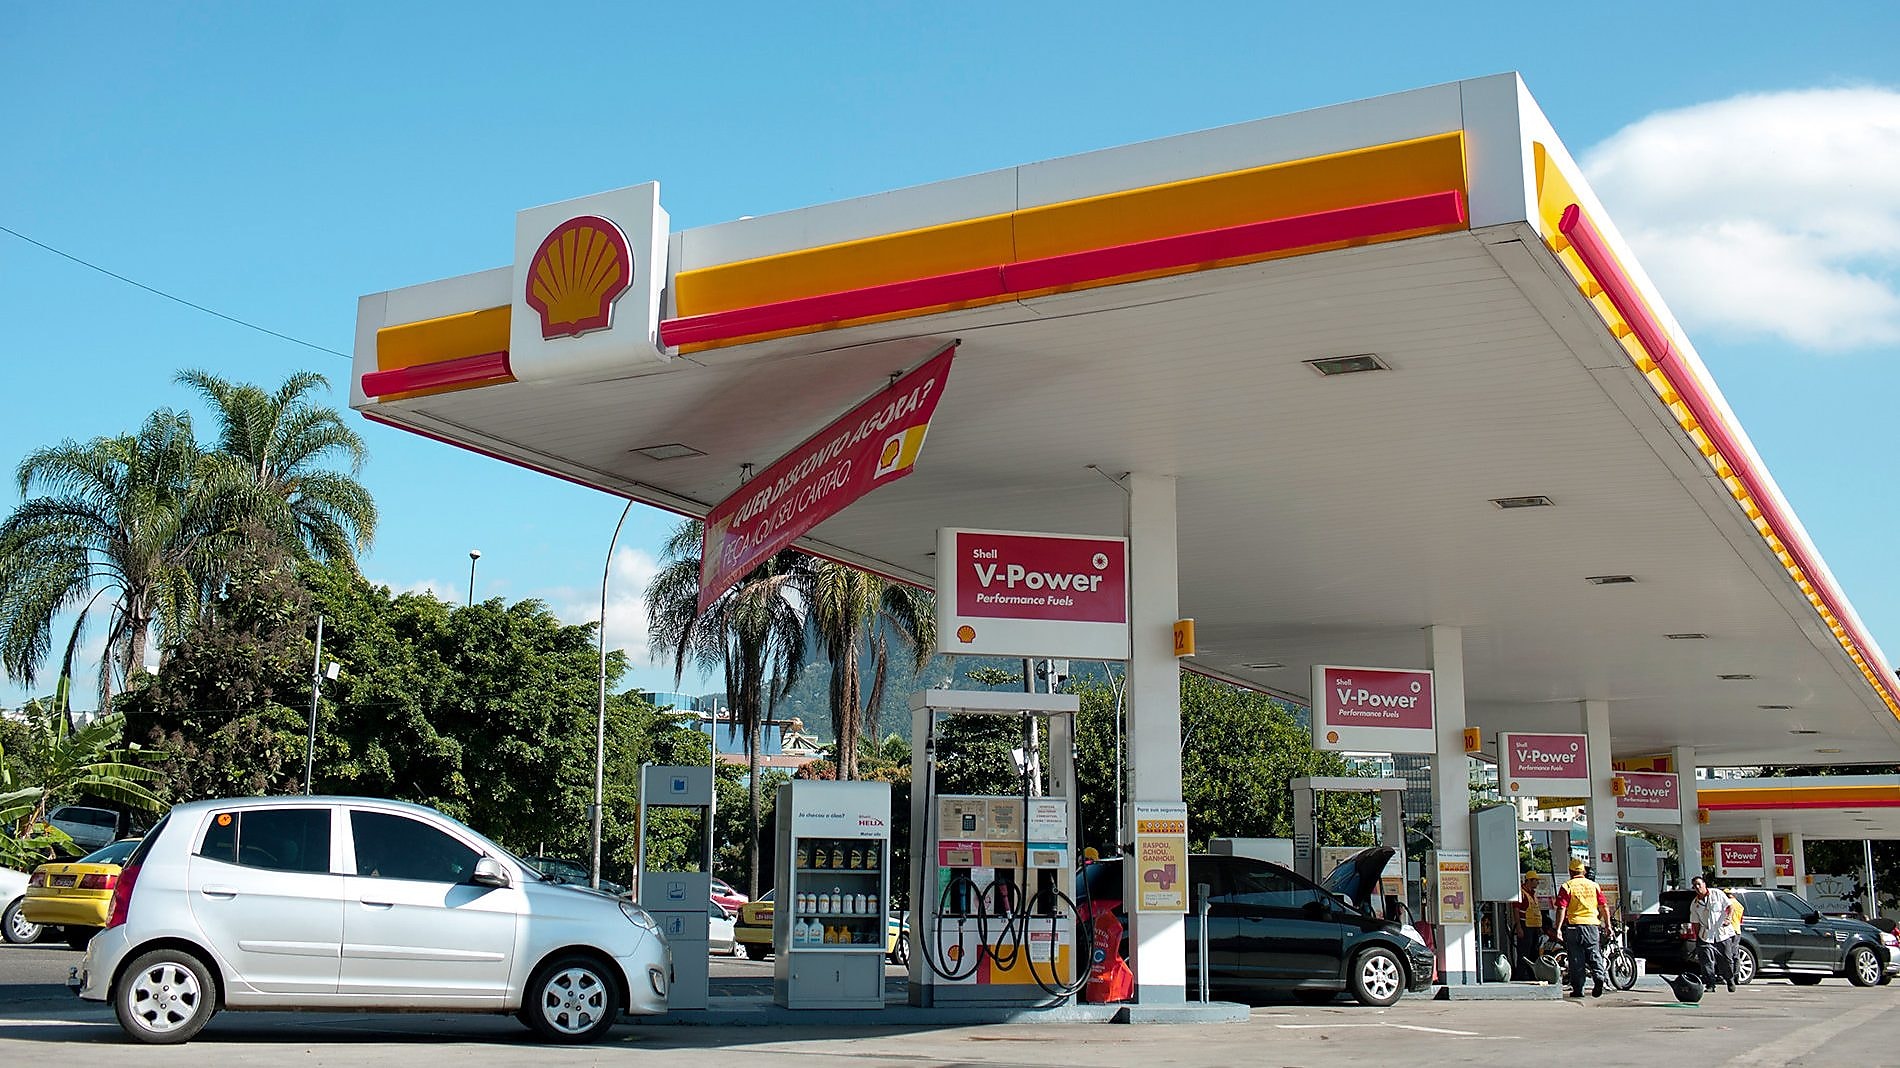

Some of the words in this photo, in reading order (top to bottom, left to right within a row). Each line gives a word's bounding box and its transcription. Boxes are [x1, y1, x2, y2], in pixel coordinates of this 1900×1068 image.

[733, 486, 773, 528] QUER
[847, 378, 936, 449] AGORA?
[973, 548, 998, 559] Shell
[973, 563, 1103, 592] V-Power
[976, 593, 1045, 605] Performance
[1047, 595, 1074, 607] Fuels
[1174, 630, 1184, 649] 12
[1336, 678, 1352, 686] Shell
[1336, 688, 1418, 708] V-Power
[1338, 708, 1381, 718] Performance
[1382, 710, 1399, 718] Fuels
[1516, 749, 1576, 763] V-Power
[1624, 784, 1670, 797] V-Power
[858, 818, 884, 826] HELIX
[1724, 852, 1757, 860] V-Power
